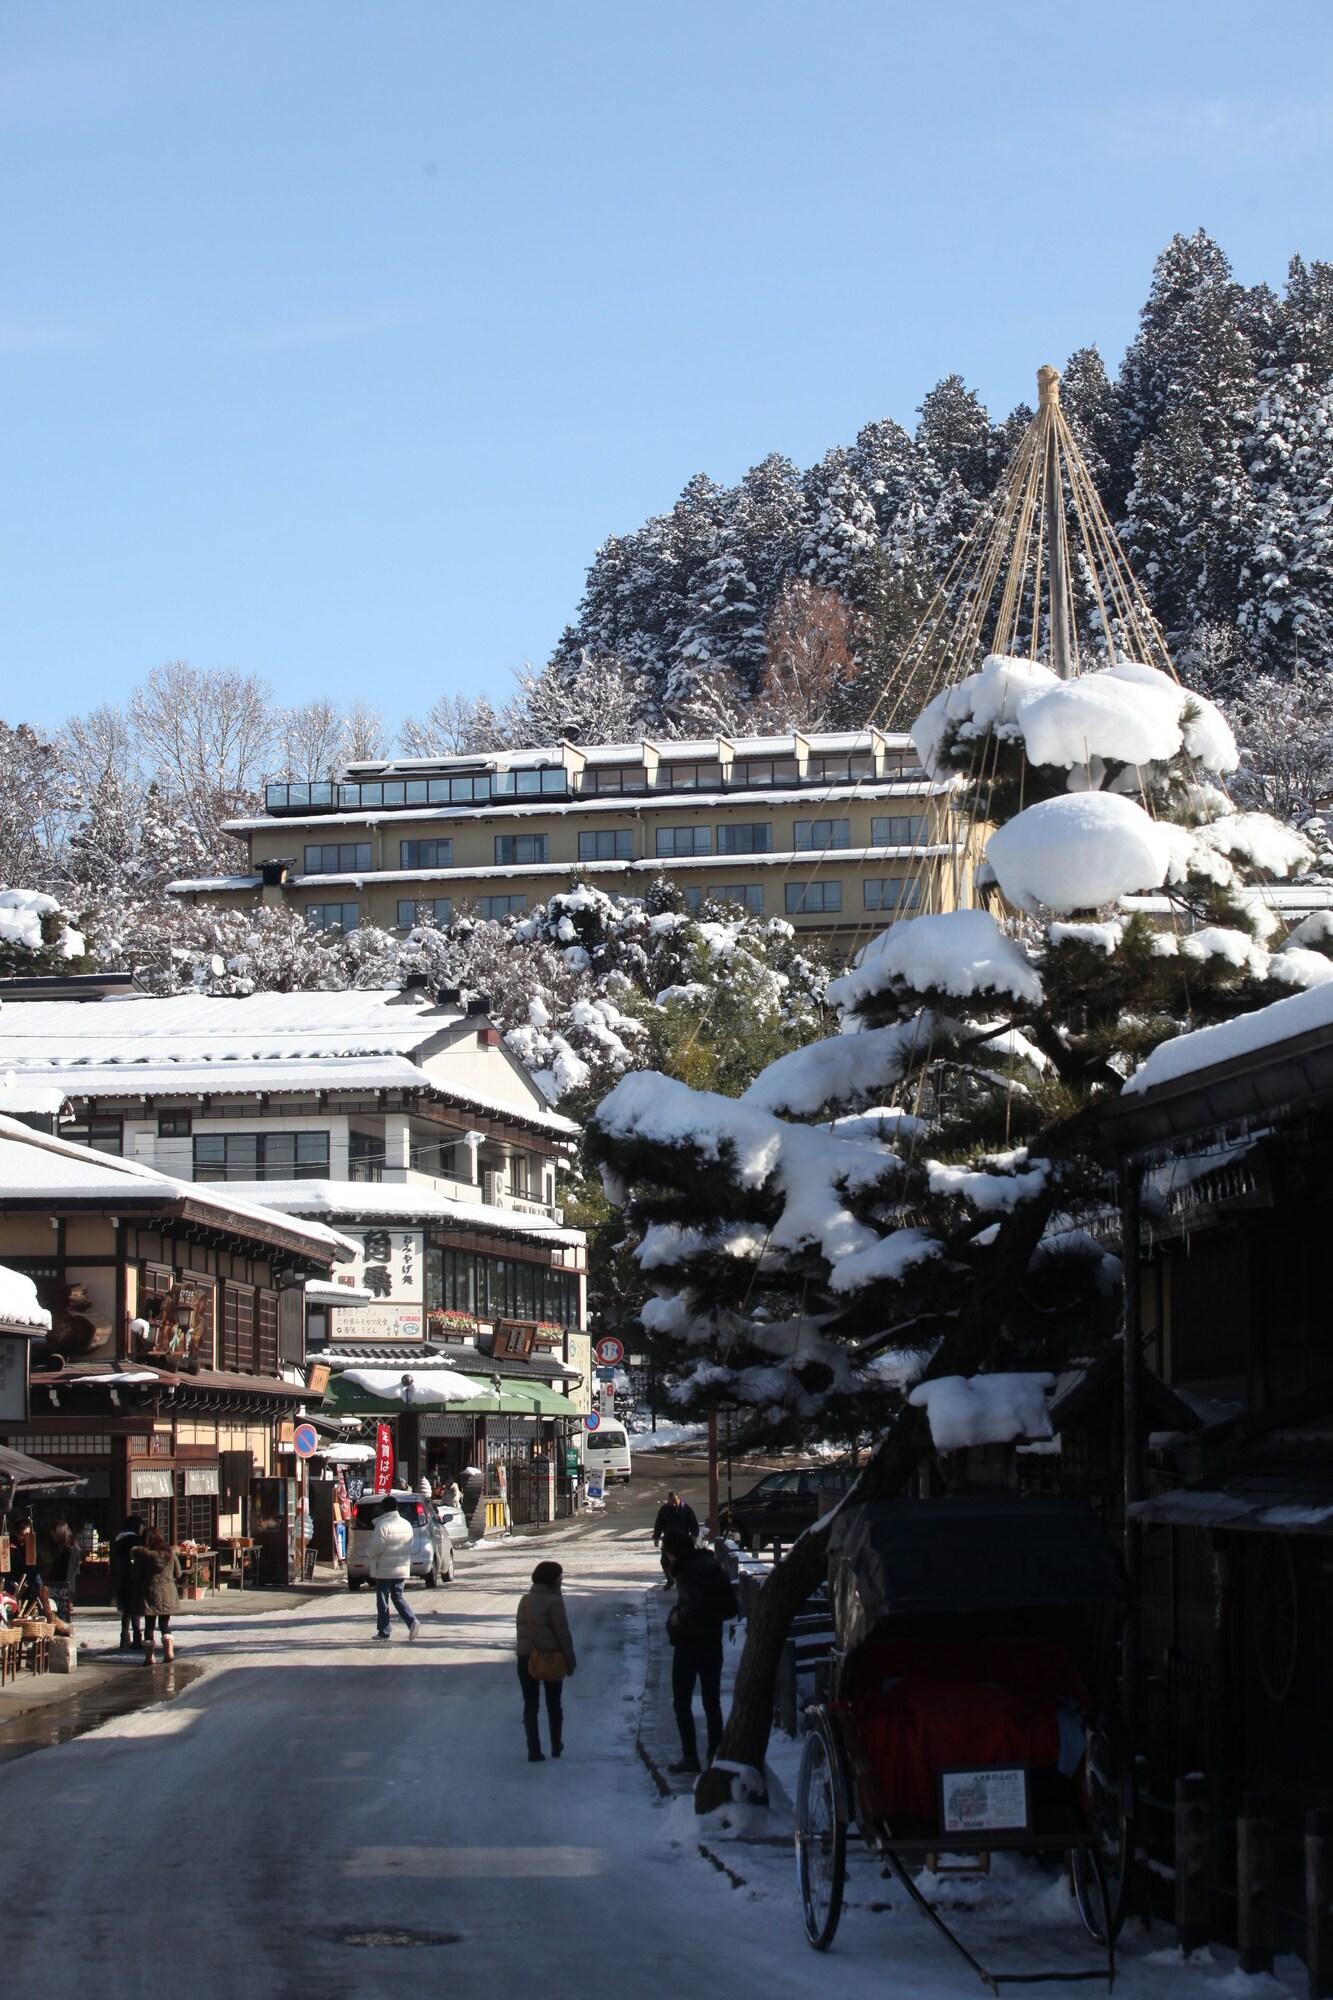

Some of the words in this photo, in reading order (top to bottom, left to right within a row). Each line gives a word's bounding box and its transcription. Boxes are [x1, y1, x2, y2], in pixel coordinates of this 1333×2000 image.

[401, 1235, 414, 1286] おみやげ処
